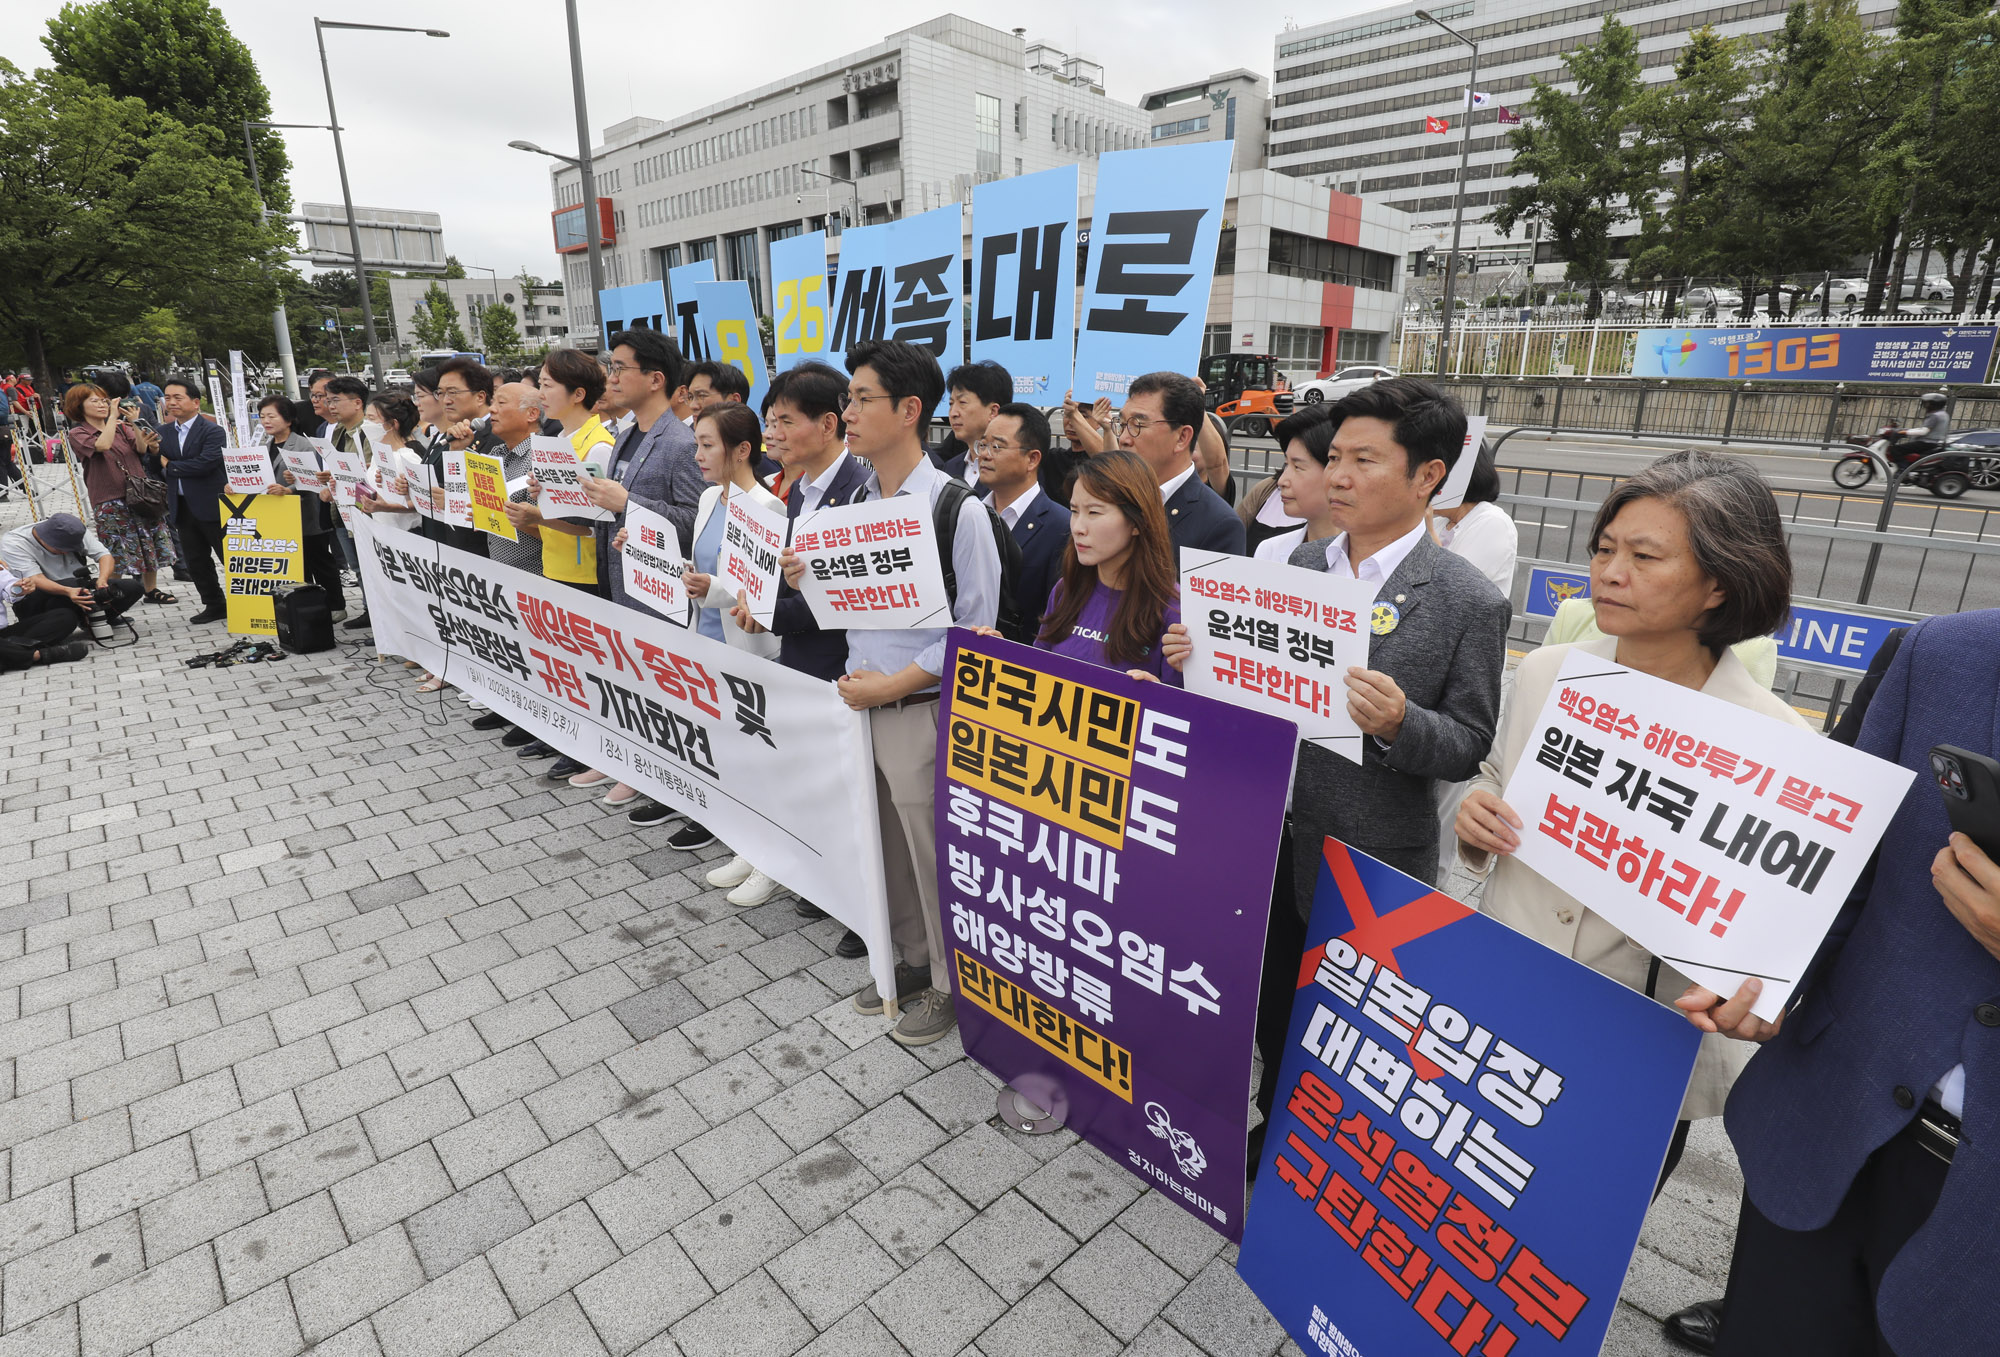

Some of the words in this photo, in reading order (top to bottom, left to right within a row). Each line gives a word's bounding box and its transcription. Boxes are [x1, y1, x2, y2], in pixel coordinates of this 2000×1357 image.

[777, 275, 824, 354] 26
[1709, 332, 1754, 346] 국방헬프콜
[1725, 333, 1840, 377] 1303
[1875, 341, 1910, 350] 병영생활
[1911, 341, 1930, 350] 고충
[1931, 341, 1950, 350] 상담
[1930, 351, 1974, 360] 신고/상담
[1870, 360, 1925, 369] 방위사업비리
[1928, 360, 1972, 369] 신고/상담
[229, 476, 265, 487] 규탄한다!
[235, 453, 264, 463] 대변하는
[242, 463, 261, 474] 정부
[533, 467, 562, 484] 윤석열
[558, 469, 580, 485] 정부
[546, 451, 577, 464] 대변하는
[473, 471, 496, 493] 대통령
[226, 518, 257, 536] 일본
[640, 524, 665, 551] 일본을
[726, 521, 742, 548] 일본
[742, 532, 754, 561] 자국
[754, 545, 777, 577] 내에
[729, 501, 747, 523] 핵오염수
[746, 515, 765, 540] 해양투기
[765, 529, 781, 549] 말고
[794, 532, 820, 553] 일본
[822, 527, 851, 549] 입장
[854, 517, 921, 543] 대변하는
[228, 556, 289, 576] 해양투기
[633, 569, 674, 604] 제소하라!
[727, 552, 763, 601] 보관하라!
[810, 553, 869, 581] 윤석열
[870, 546, 913, 576] 정부
[825, 582, 920, 612] 규탄한다!
[1189, 575, 1251, 604] 핵오염수
[1254, 588, 1318, 623] 해양투기
[1322, 604, 1357, 634] 방조
[396, 548, 519, 631] 방사성오염수
[516, 591, 645, 682] 해양투기
[633, 637, 721, 721] 중단
[720, 671, 778, 750] 및
[1072, 625, 1103, 642] TICAL
[1207, 609, 1279, 654] 윤석열
[1286, 627, 1335, 669] 정부
[1777, 617, 1869, 659] INE
[427, 603, 533, 682] 윤석열정부
[528, 647, 591, 711] 규탄
[585, 671, 720, 781] 기자회견
[487, 677, 510, 702] 2023년
[511, 690, 522, 709] 8월
[522, 696, 551, 725] 24일(목)
[1212, 650, 1331, 718] 규탄한다!
[956, 652, 1191, 778] 한국시민도
[633, 753, 652, 779] 용산
[654, 765, 695, 801] 대통령실
[695, 787, 708, 809] 앞
[1557, 687, 1640, 740] 핵오염수
[1643, 722, 1776, 797] 해양투기
[1775, 775, 1863, 834] 말고
[951, 720, 1179, 856] 일본시민도
[1535, 726, 1605, 789] 일본
[1604, 758, 1699, 834] 자국
[1698, 802, 1836, 896] 내에
[947, 785, 1120, 903] 후쿠시마
[1537, 793, 1746, 939] 보관하라!
[948, 843, 1221, 1017] 방사성오염수
[950, 902, 1114, 1026] 해양방류
[956, 953, 1130, 1091] 반대한다!
[1313, 936, 1566, 1128] 일본입장
[1300, 1001, 1537, 1210] 대변하는
[1127, 1149, 1228, 1225] 정치하는엄마들
[1286, 1070, 1590, 1342] 윤석열정부
[1311, 1304, 1328, 1330] 일본
